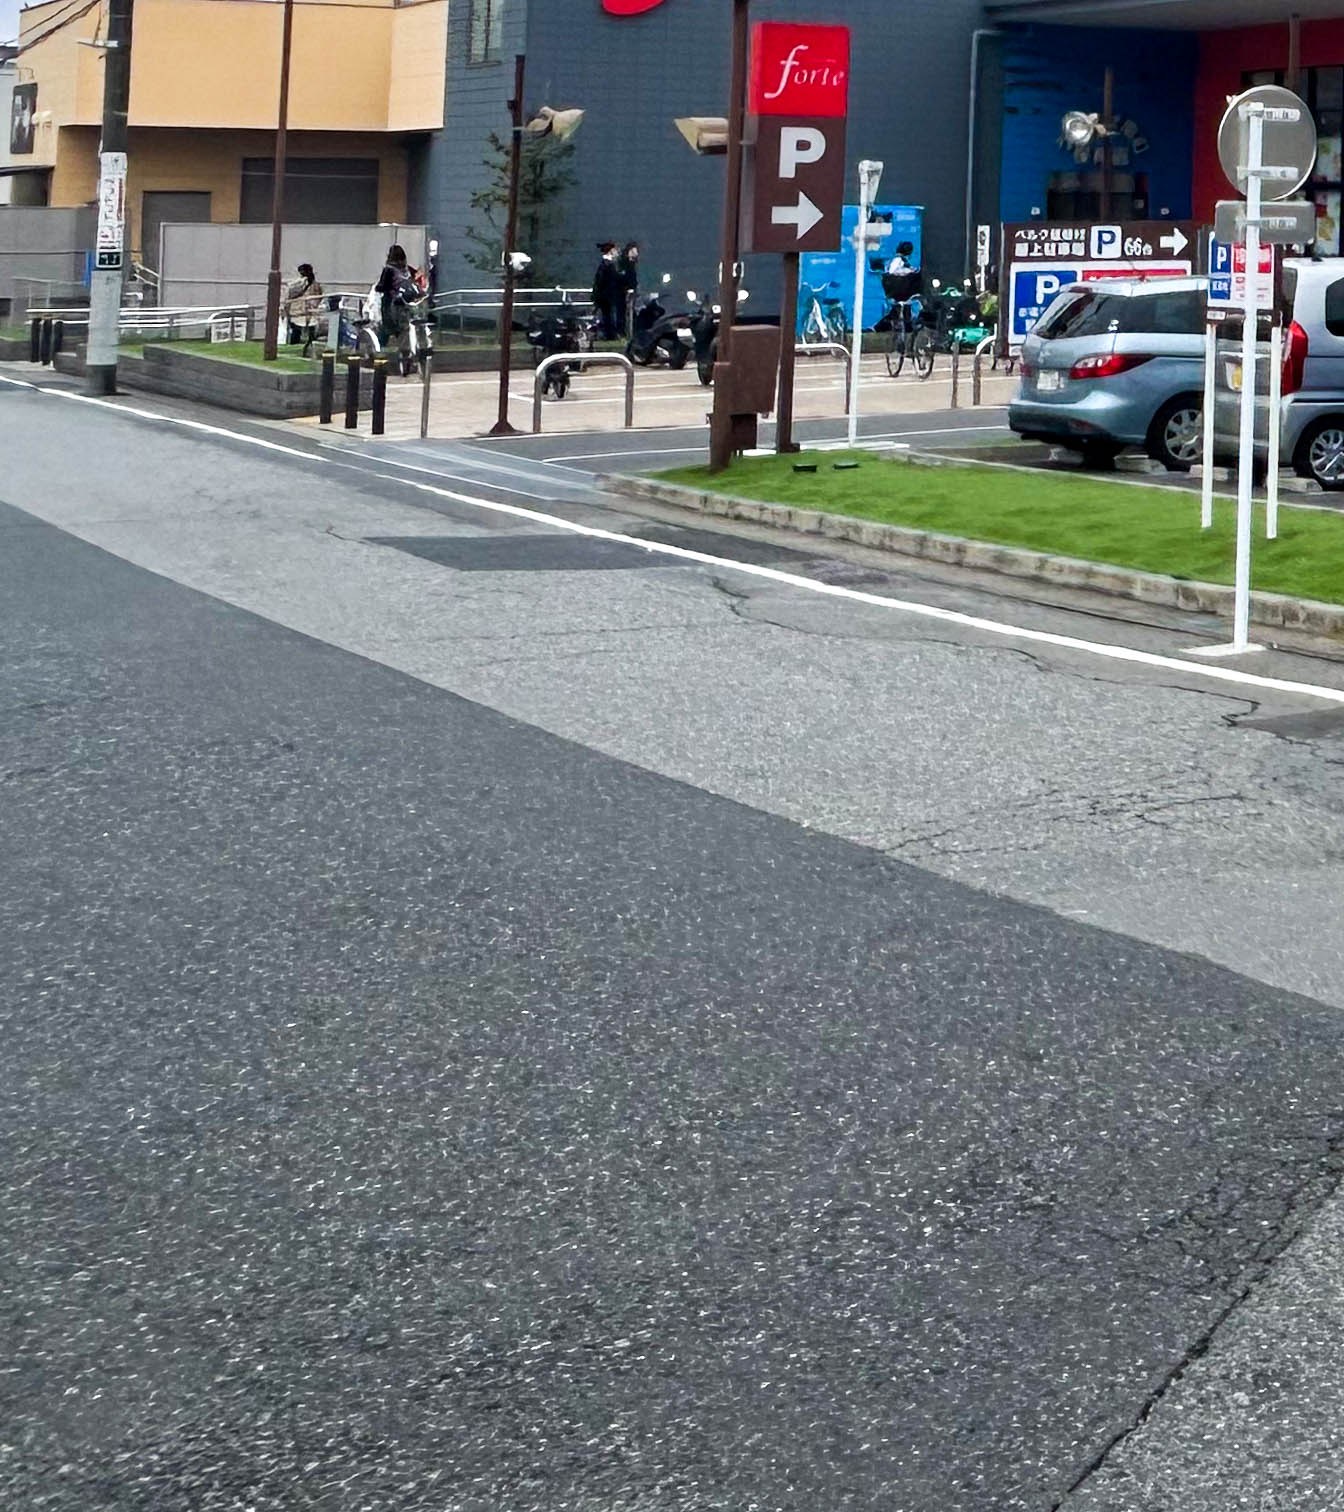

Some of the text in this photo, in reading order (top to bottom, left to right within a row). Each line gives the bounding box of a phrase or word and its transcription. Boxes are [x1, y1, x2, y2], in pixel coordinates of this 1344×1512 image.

[764, 44, 845, 100] forte
[778, 126, 827, 179] P
[1097, 230, 1116, 255] P
[1217, 246, 1227, 270] P
[1036, 274, 1060, 304] P
